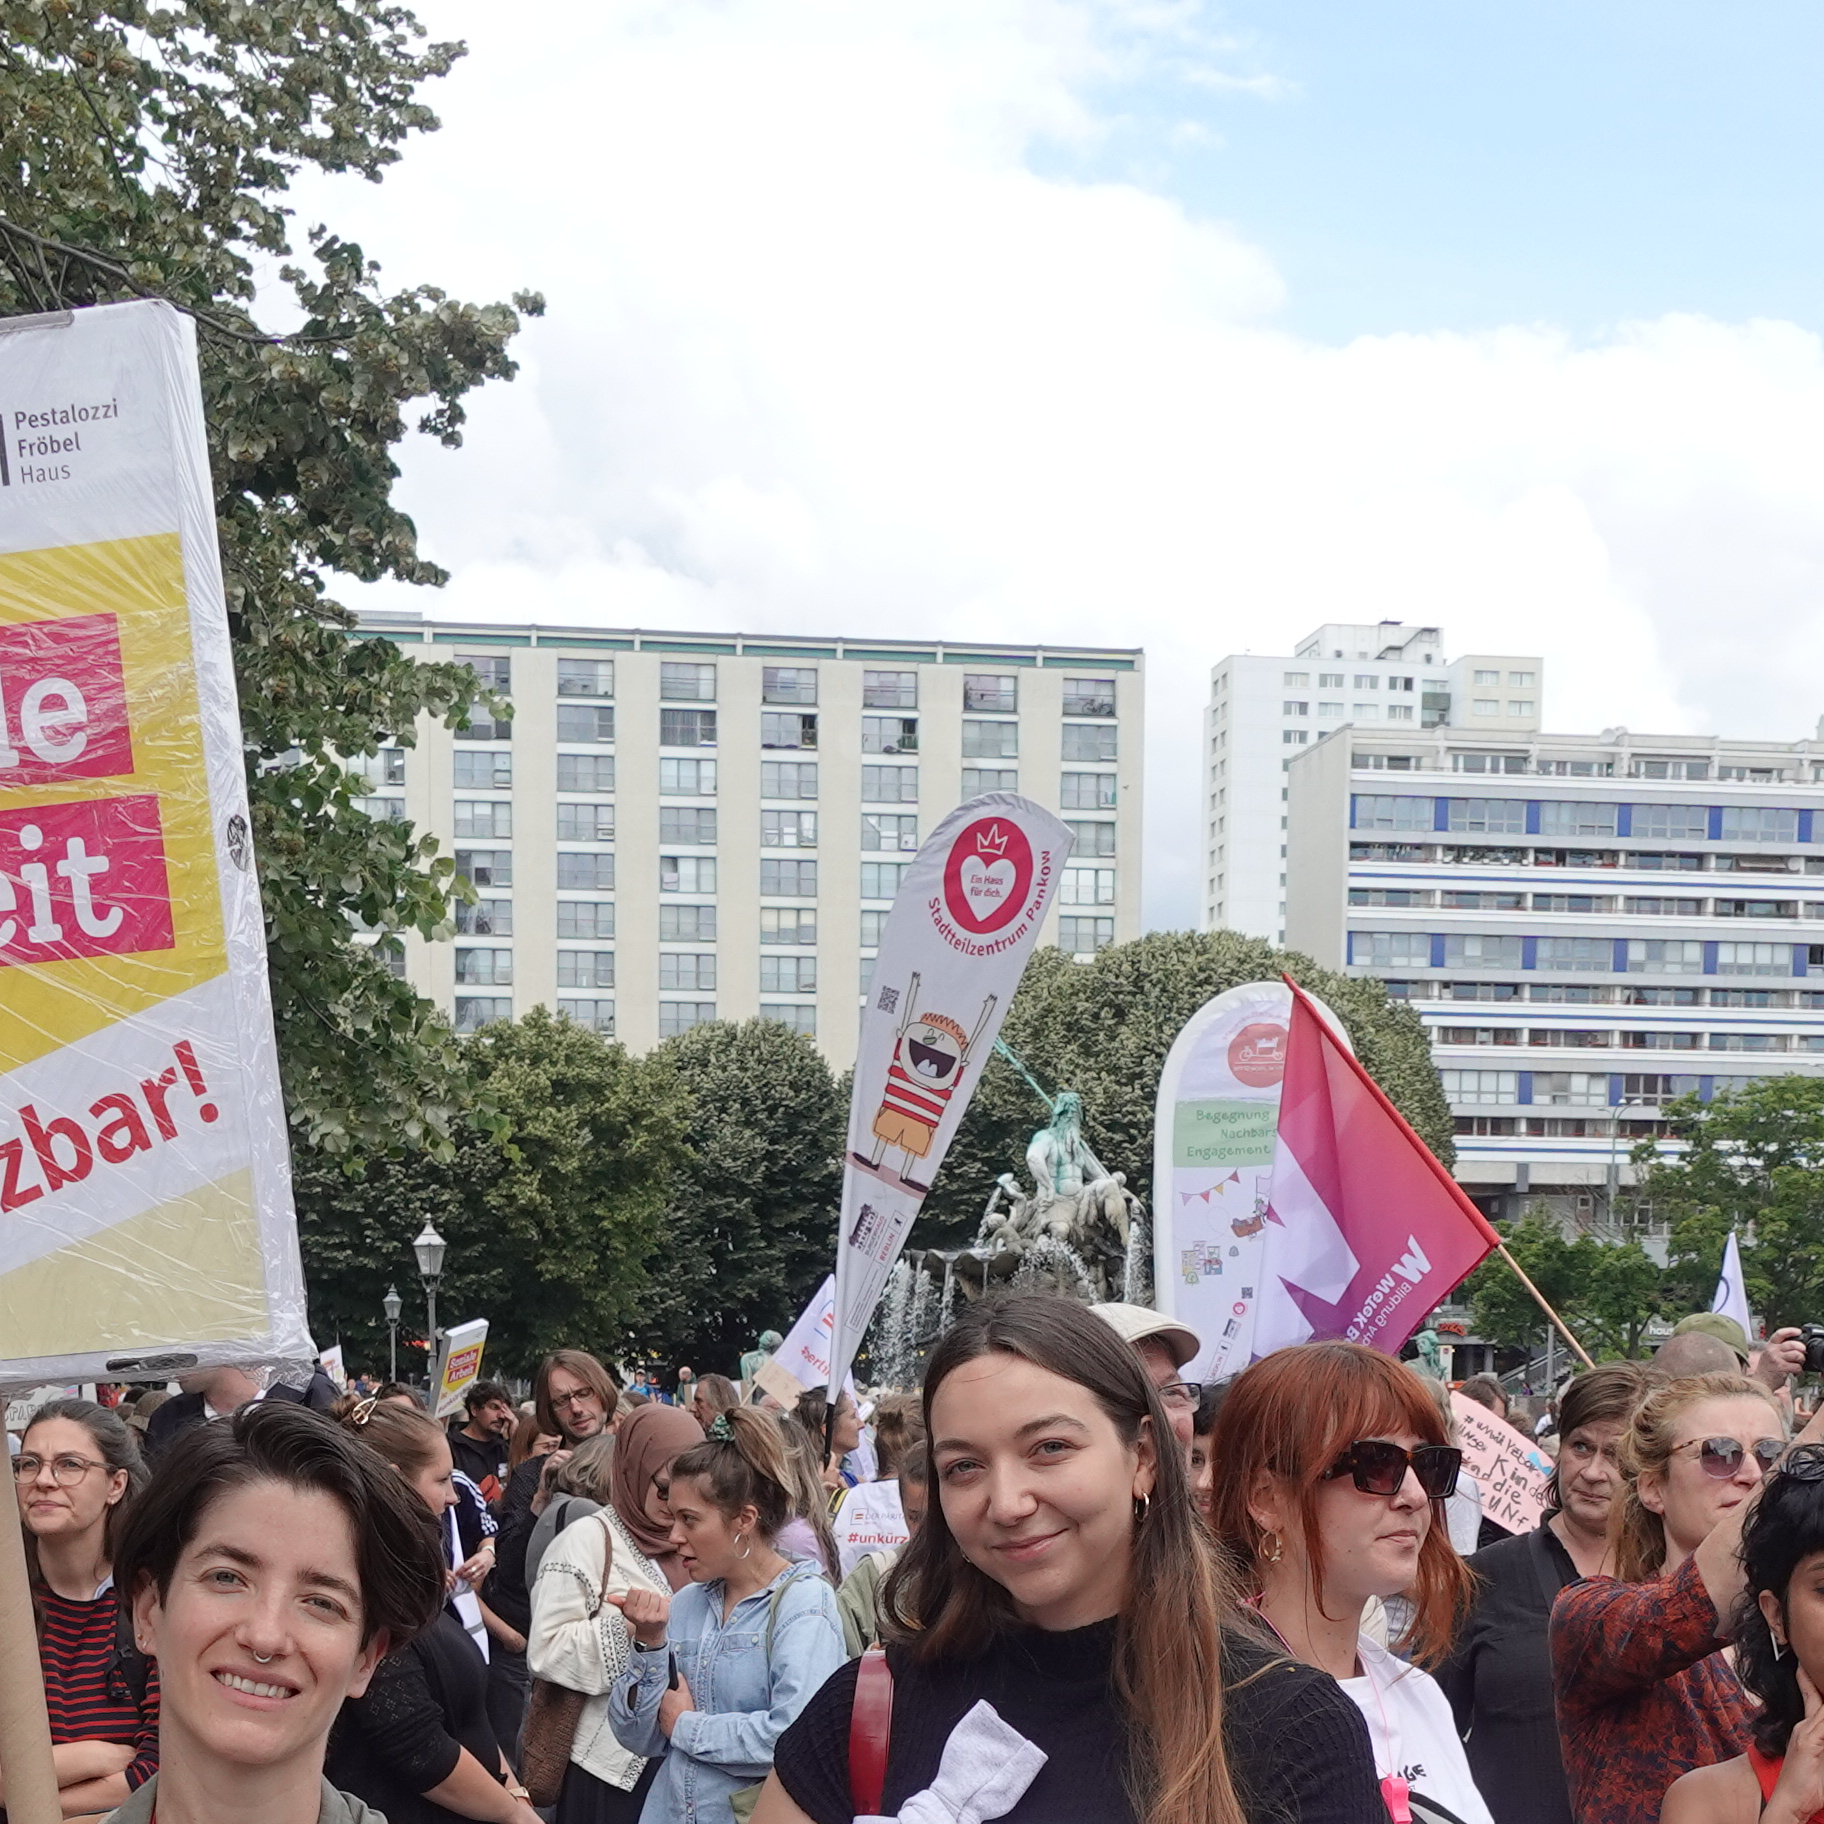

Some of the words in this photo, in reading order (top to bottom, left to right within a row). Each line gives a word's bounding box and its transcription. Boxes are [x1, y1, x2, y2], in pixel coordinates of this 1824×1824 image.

[14, 398, 119, 430] Pestalozzi
[18, 431, 81, 458] Fröbel
[21, 464, 71, 484] Haus
[970, 875, 983, 884] Ein
[984, 875, 1004, 885] Haus
[929, 897, 1028, 956] Stadtteilzentrum
[1026, 851, 1051, 921] Pankow
[1197, 1110, 1270, 1124] Begegnung
[1221, 1128, 1277, 1139] Nachbars
[1187, 1145, 1272, 1160] Engagement
[879, 1233, 895, 1261] BERLIN
[1492, 1478, 1523, 1506] die
[847, 1532, 908, 1545] #unkürz
